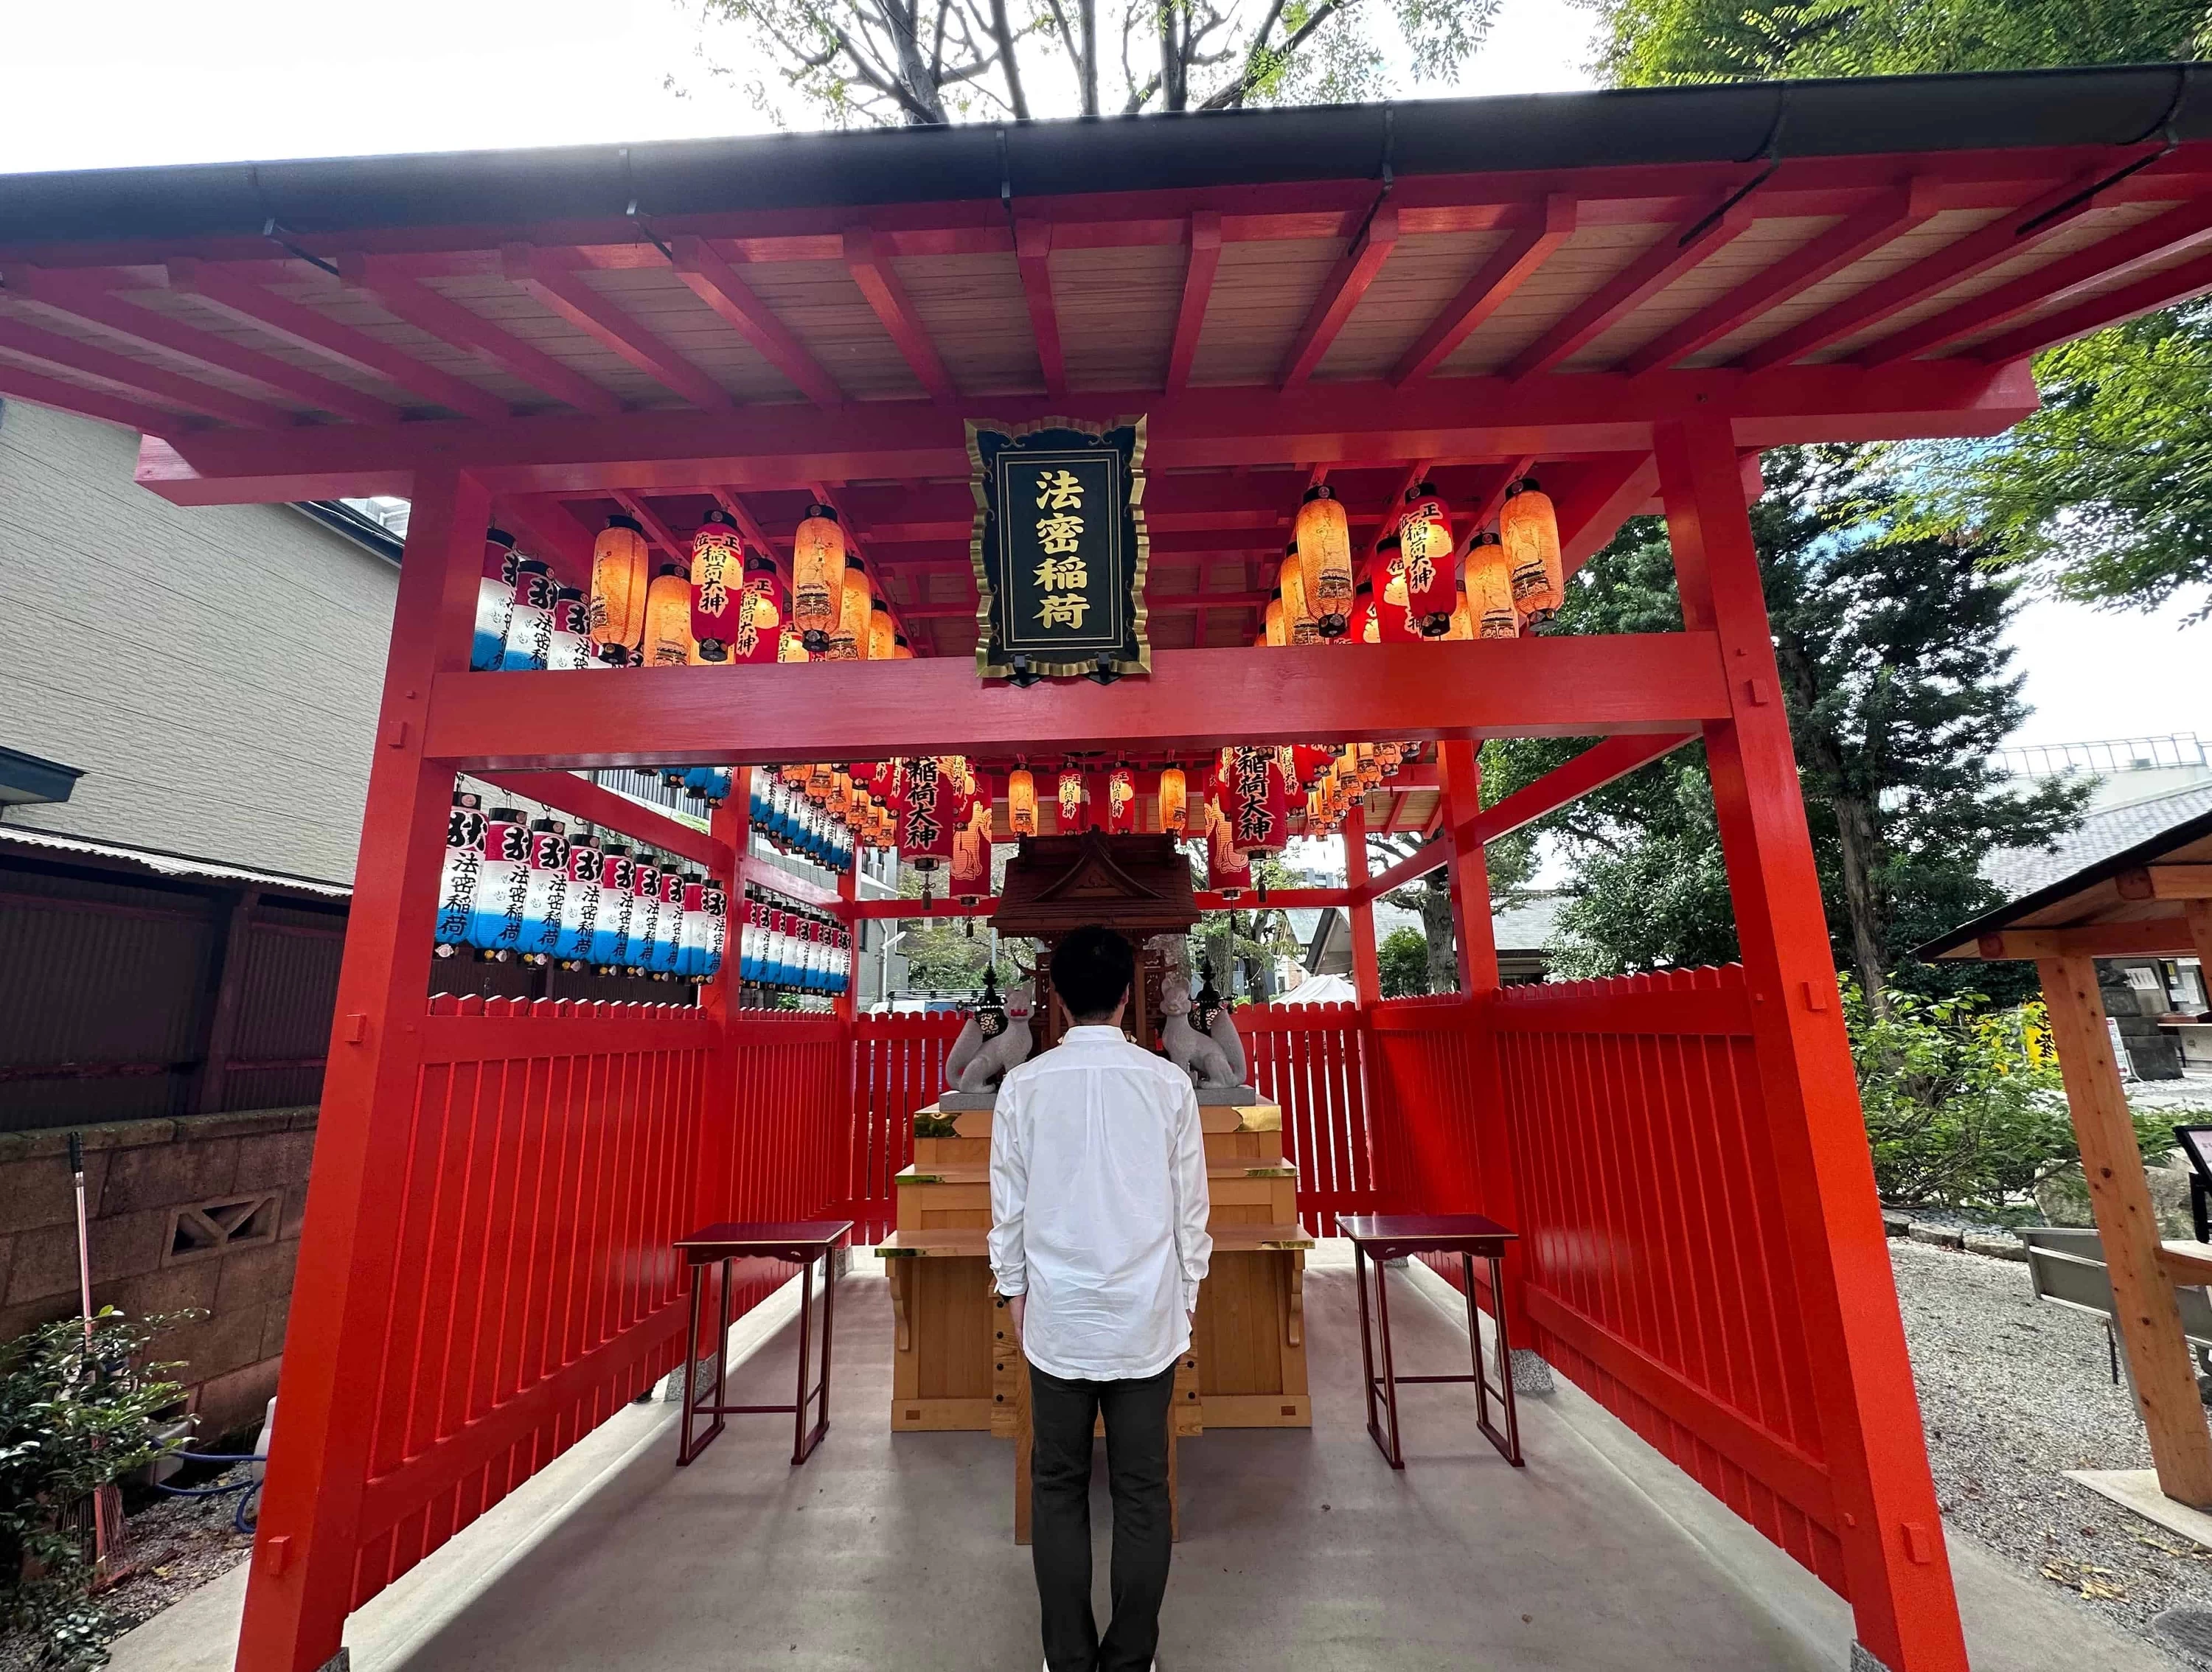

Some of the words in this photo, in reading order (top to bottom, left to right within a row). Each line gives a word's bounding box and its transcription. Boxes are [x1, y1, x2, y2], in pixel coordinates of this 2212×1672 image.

[700, 545, 727, 613] 稲荷大神
[1032, 470, 1091, 630] 法密稲荷
[1405, 520, 1433, 589] 稲荷大神
[737, 591, 759, 653] 稲荷大神
[905, 757, 942, 849] 稲荷大神
[1063, 781, 1076, 818] 稲荷大神
[1238, 749, 1273, 841] 稲荷大神
[439, 851, 479, 936] 法密稲荷
[498, 864, 530, 943] 法密稲荷
[537, 873, 567, 946] 法密稲荷
[571, 885, 601, 955] 法密稲荷
